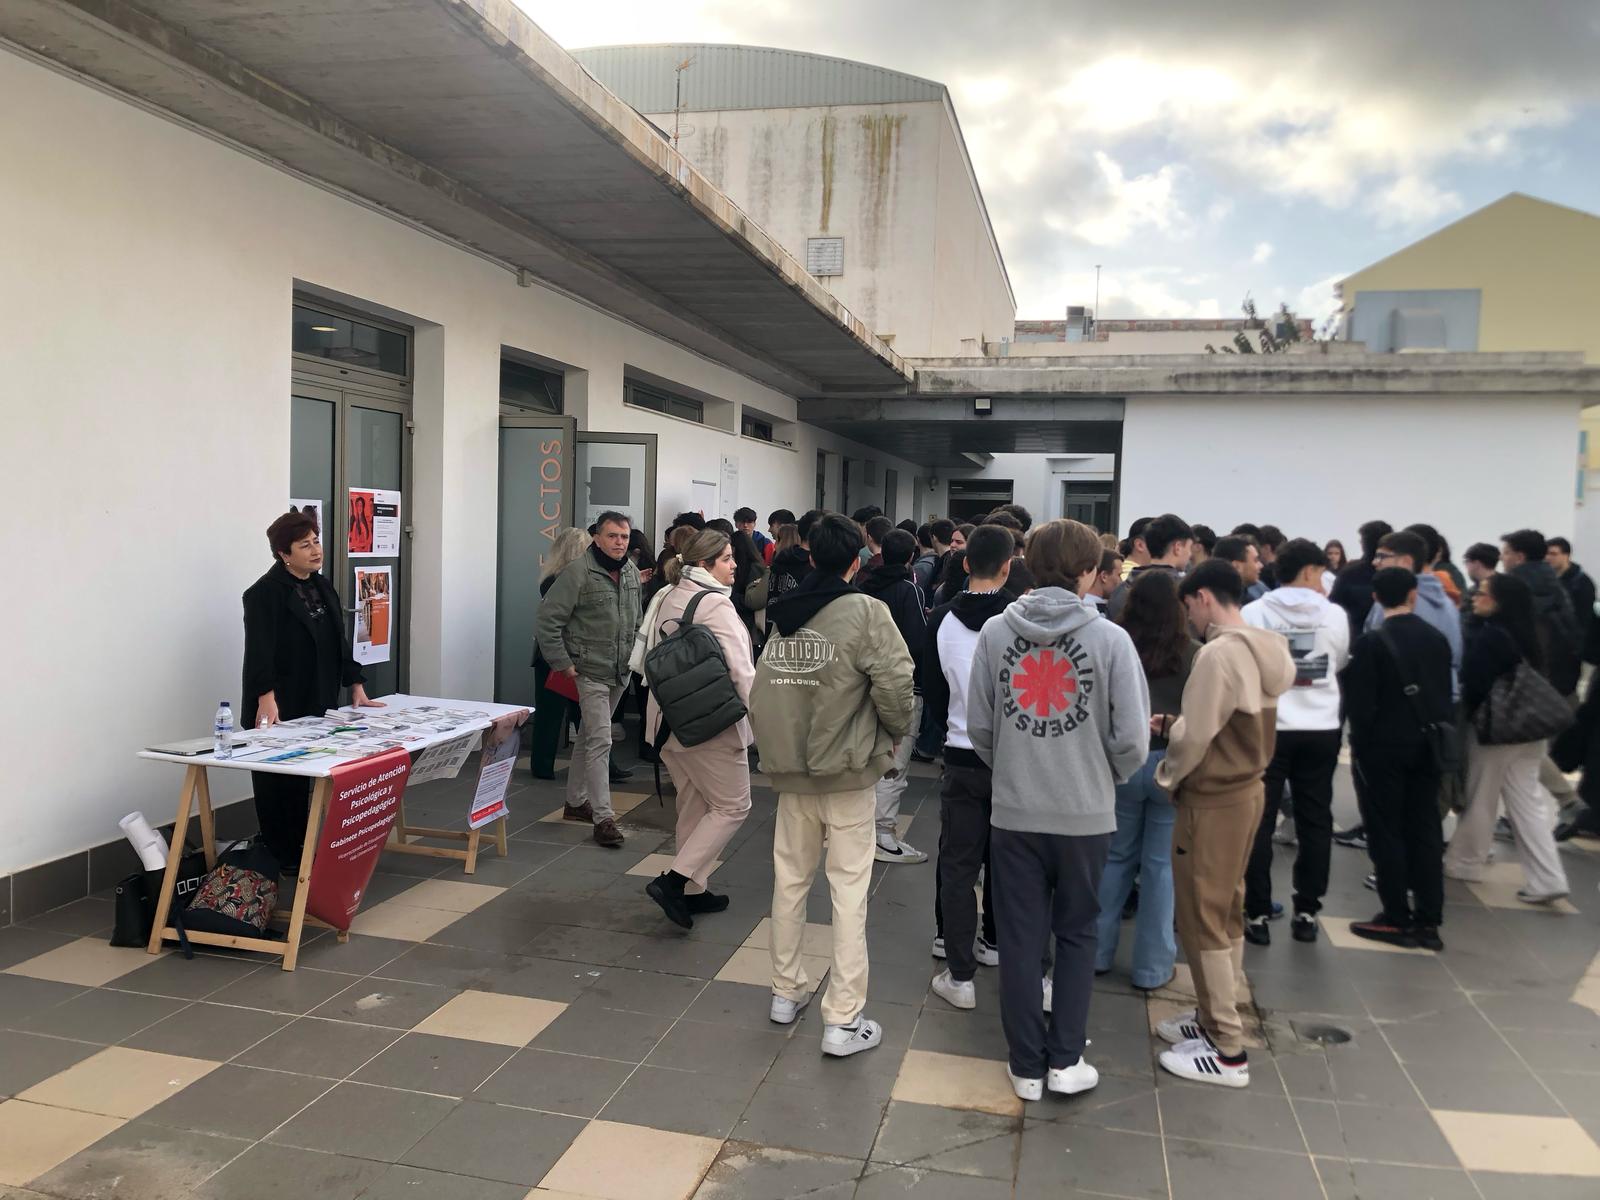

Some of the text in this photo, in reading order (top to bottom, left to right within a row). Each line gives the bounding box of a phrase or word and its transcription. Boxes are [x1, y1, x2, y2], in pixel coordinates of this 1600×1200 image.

[540, 439, 562, 541] ACTOS
[770, 678, 820, 687] WORLDWIDE
[1014, 680, 1094, 738] PEPPERS
[339, 764, 406, 801] Servicio de Atención
[350, 787, 388, 810] Psicológica
[341, 796, 396, 828] Psicopedagógica
[330, 833, 358, 849] Gabinete
